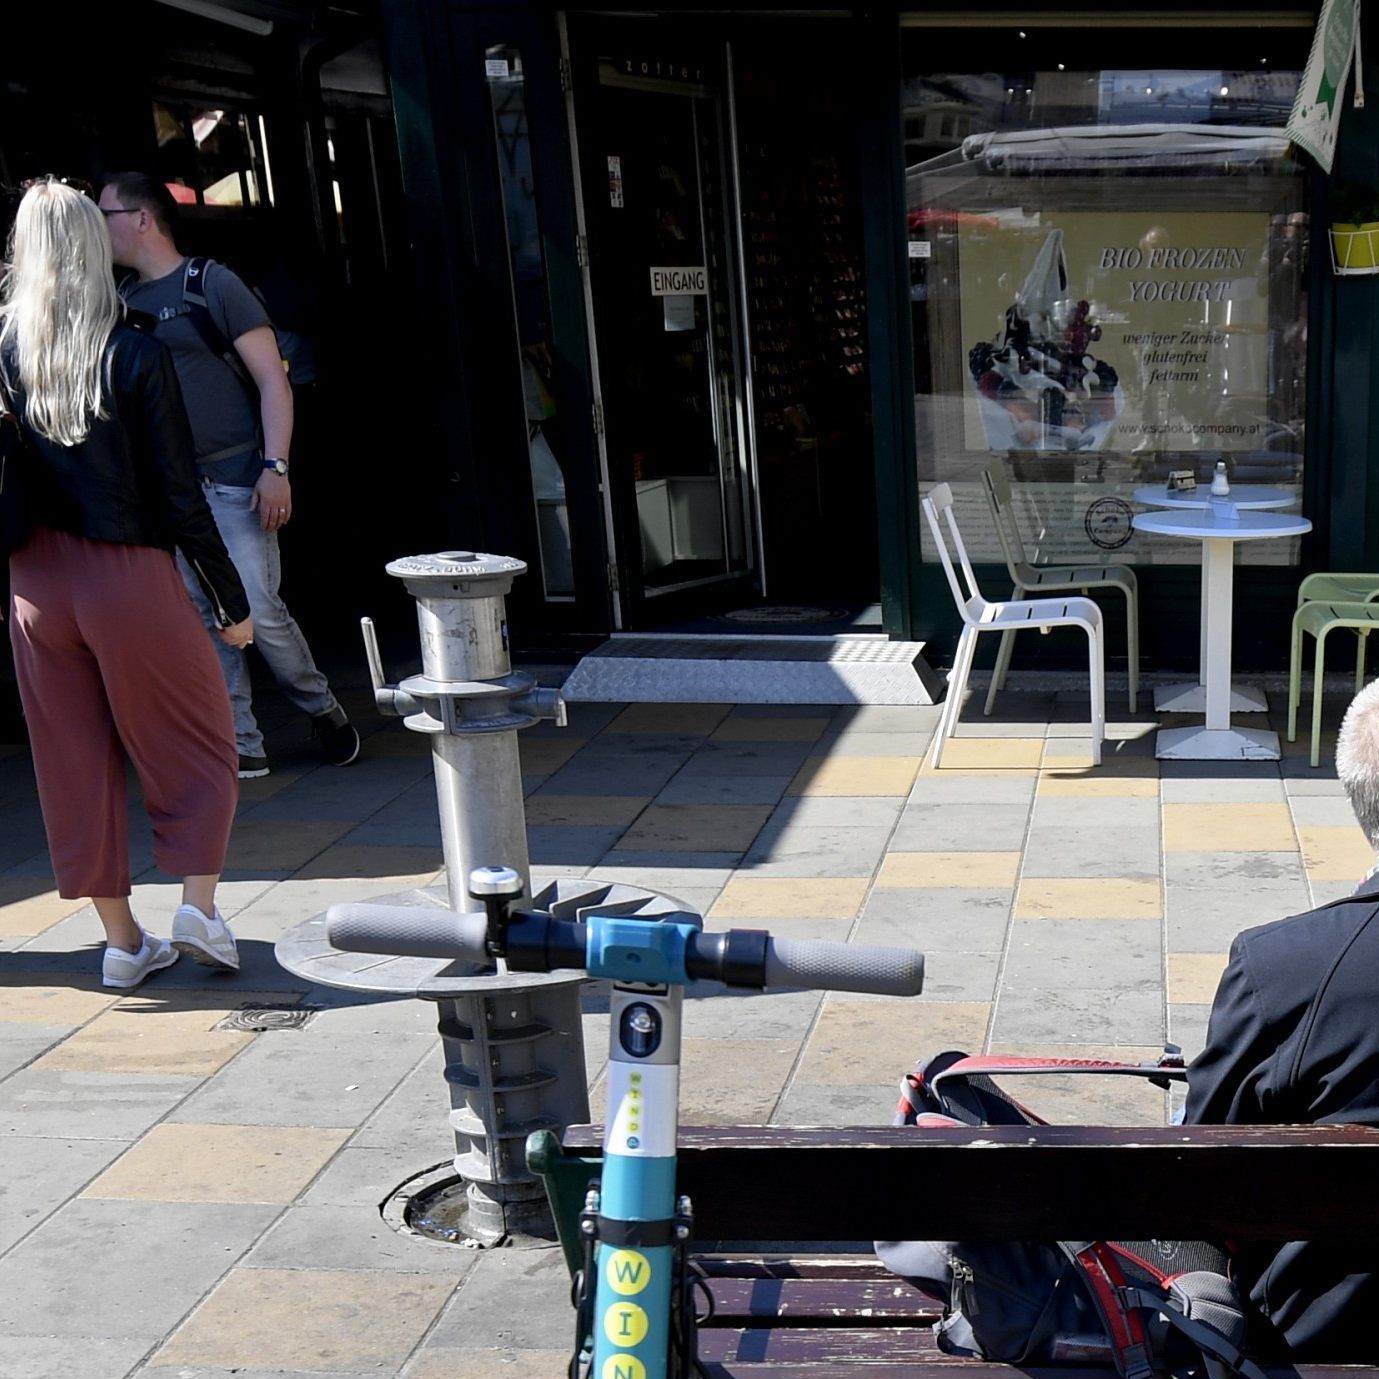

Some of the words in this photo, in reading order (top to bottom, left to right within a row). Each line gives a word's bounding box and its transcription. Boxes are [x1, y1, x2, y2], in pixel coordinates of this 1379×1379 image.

[1100, 247, 1142, 269] BIO
[1146, 247, 1247, 269] FROZEN
[654, 271, 704, 291] EINGANG
[1128, 280, 1232, 302] YOGURT
[1122, 331, 1177, 345] weniger
[1143, 350, 1208, 365] glutenfrei
[1149, 369, 1199, 385] fettarm
